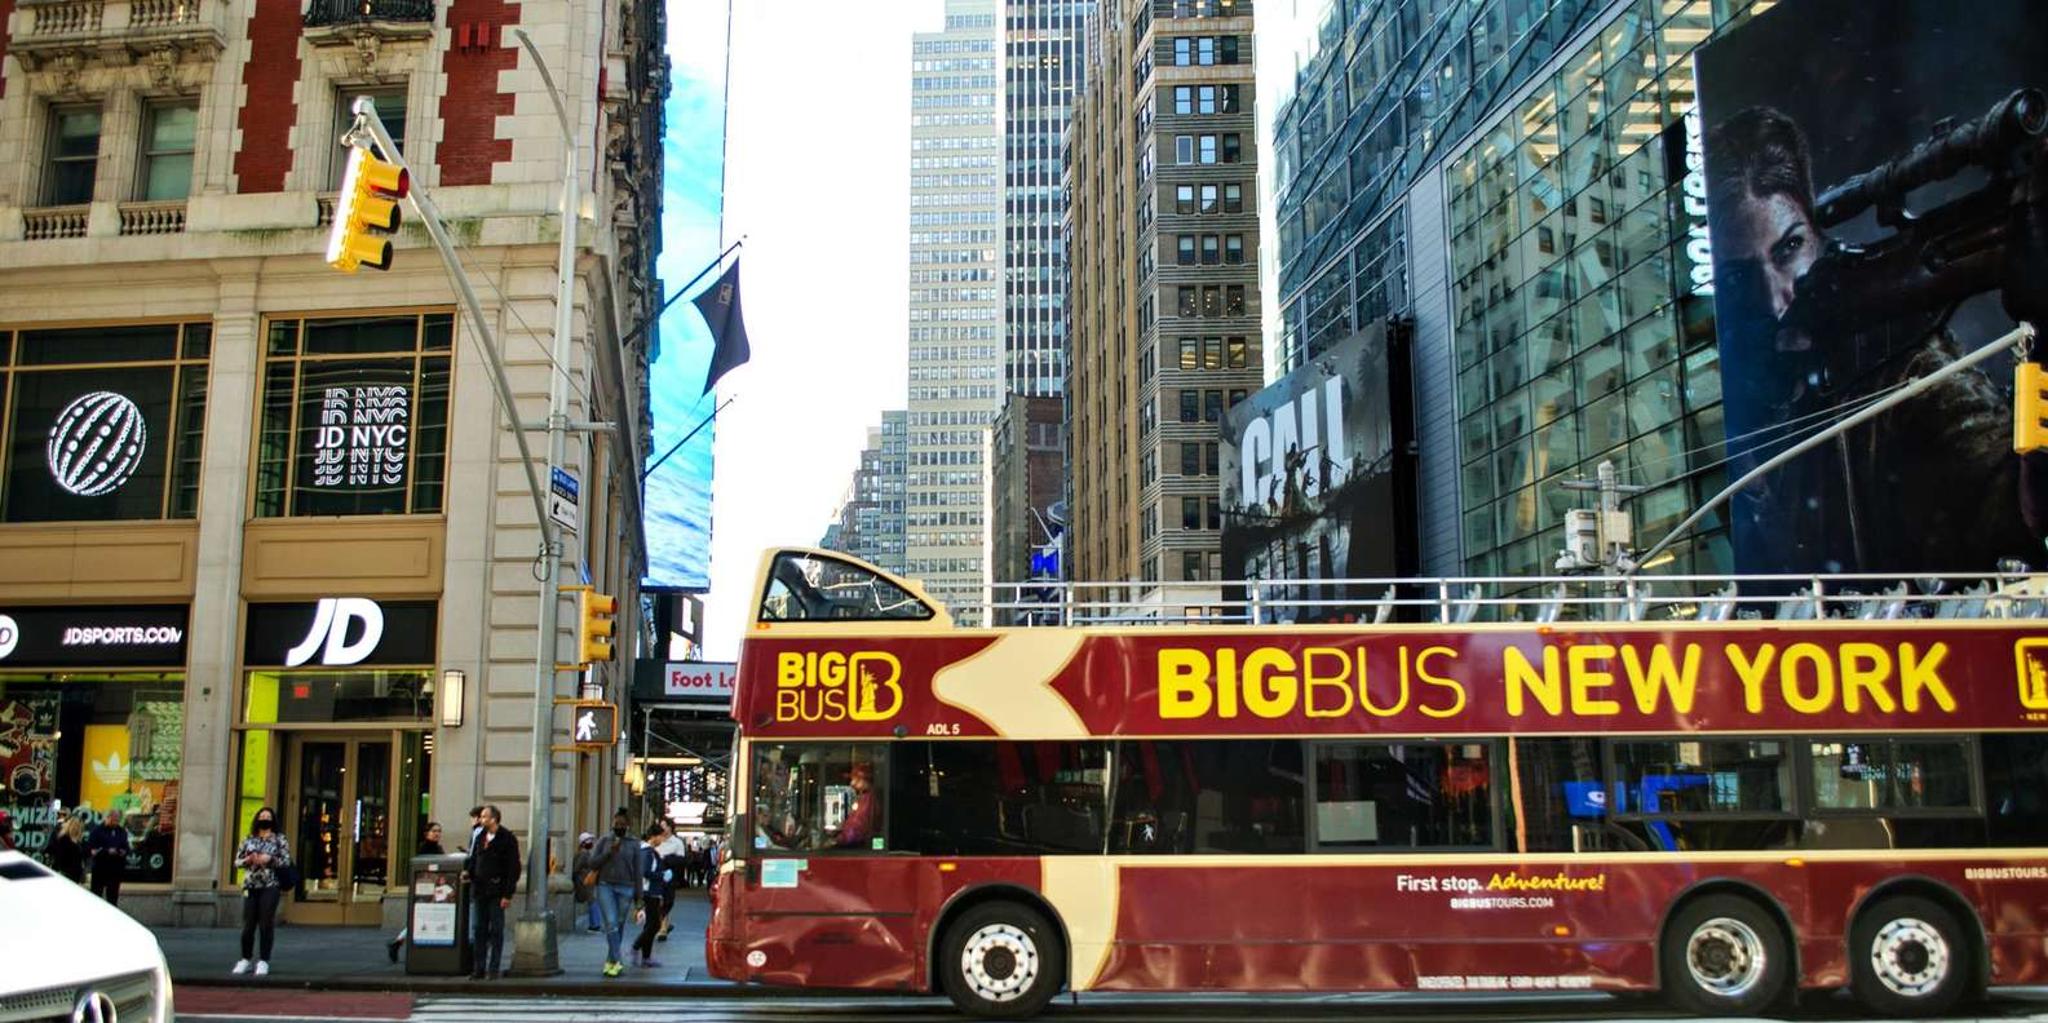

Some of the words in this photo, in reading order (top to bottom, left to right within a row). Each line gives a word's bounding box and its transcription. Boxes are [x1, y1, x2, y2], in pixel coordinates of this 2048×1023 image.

[315, 426, 345, 448] JD
[352, 425, 407, 447] NYC
[1241, 374, 1353, 509] CALL
[286, 598, 384, 667] JD
[672, 671, 712, 688] Foot
[778, 651, 847, 688] BIG
[1503, 642, 1701, 717] NEW
[1725, 642, 1957, 714] YORK
[776, 688, 846, 721] BUS
[926, 723, 950, 735] ADL
[952, 723, 960, 735] 5
[1396, 875, 1438, 891] First
[1441, 877, 1483, 893] stop.
[1486, 872, 1606, 891] Adventure!
[1450, 897, 1554, 910] BIGBUSTOURS.COM
